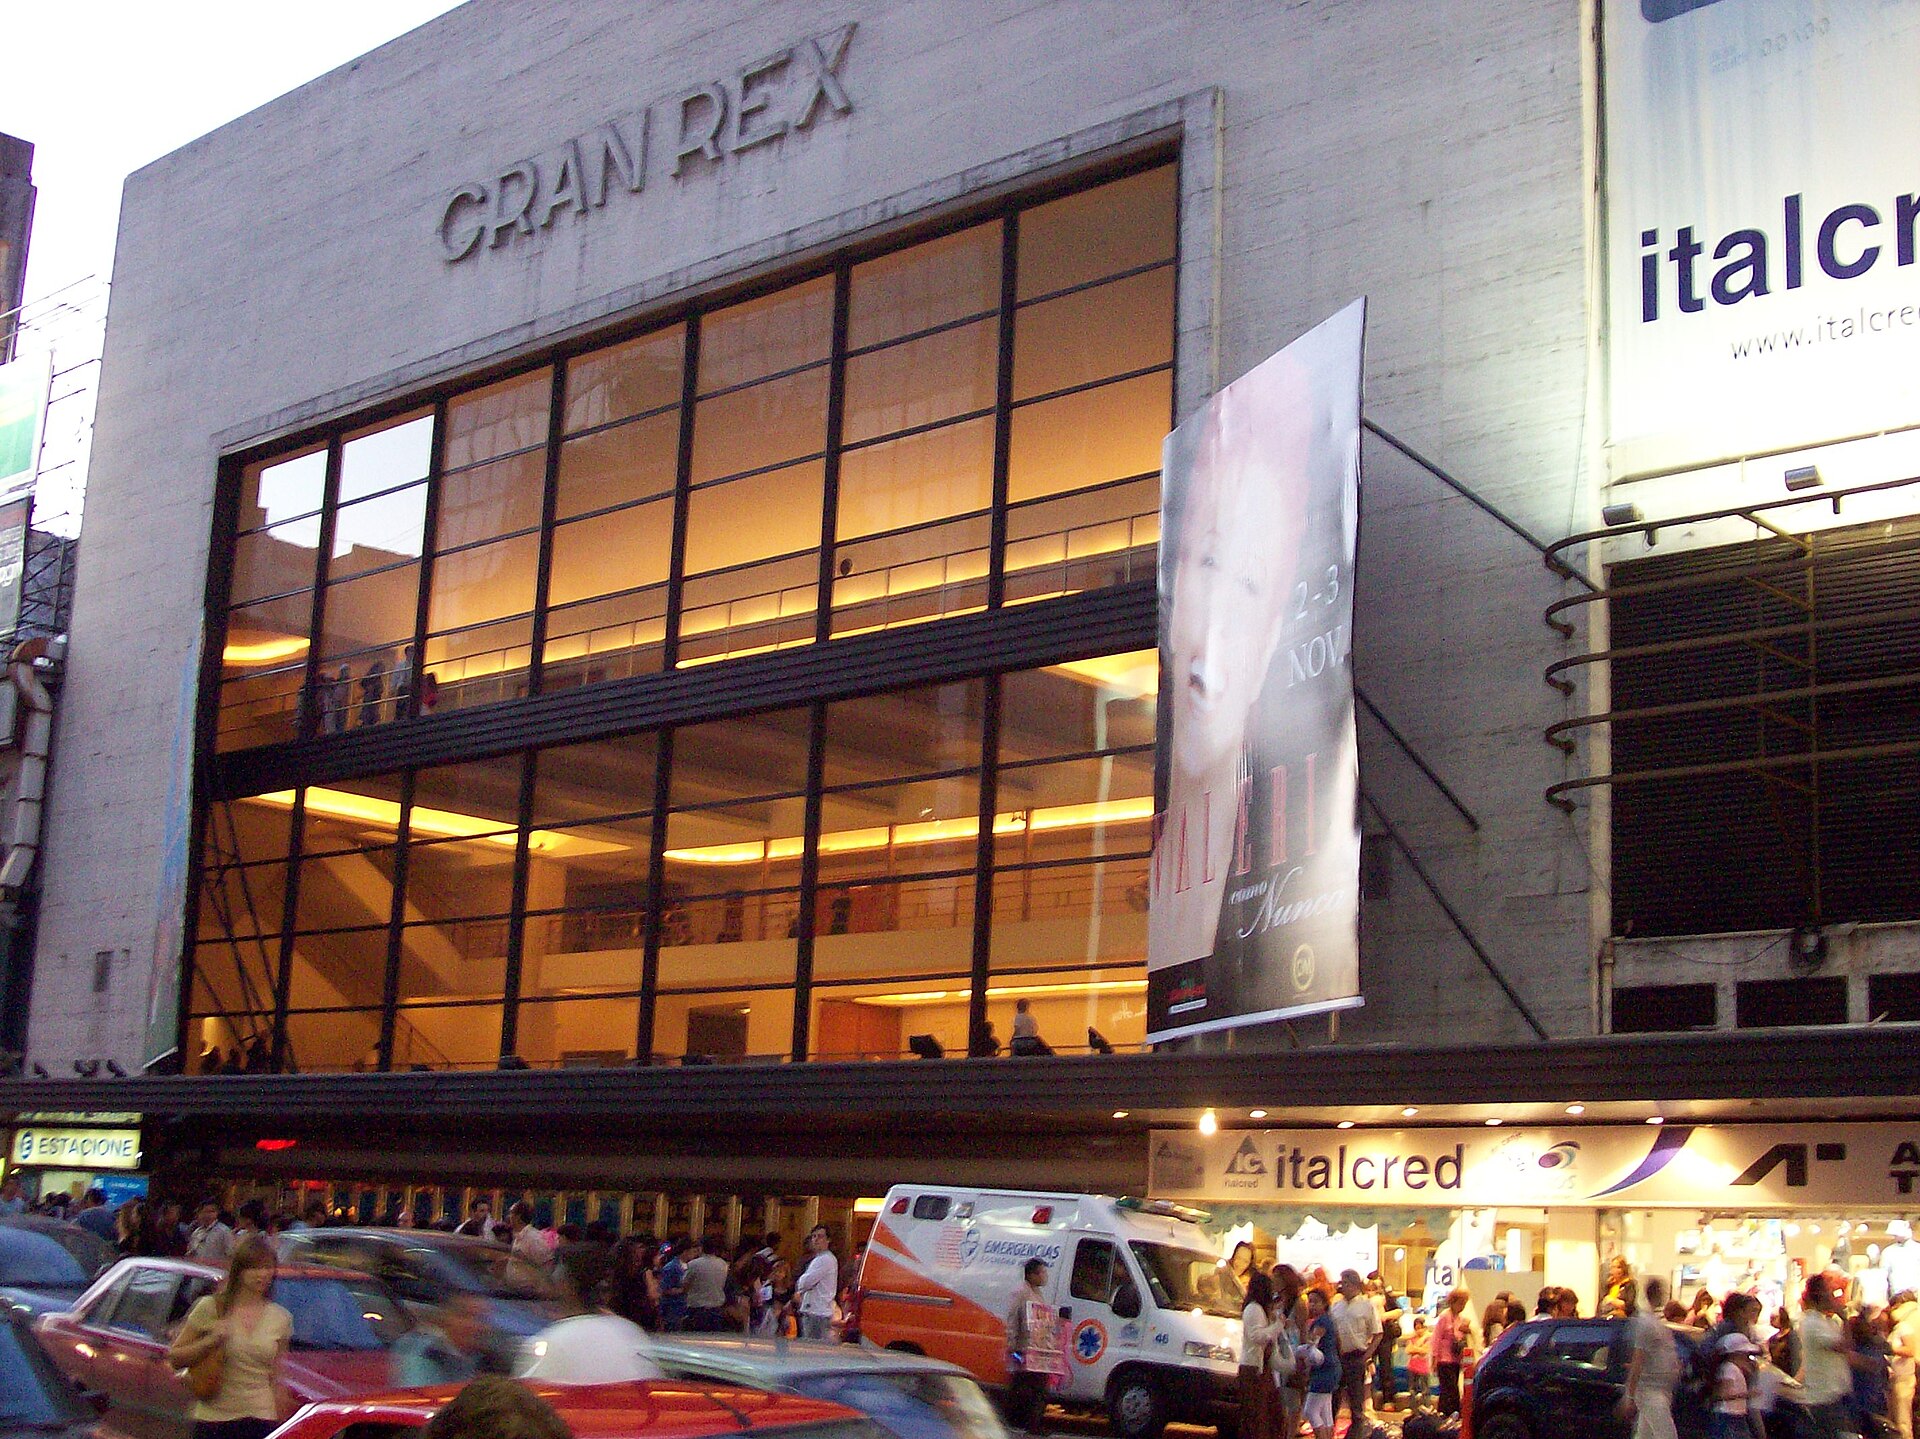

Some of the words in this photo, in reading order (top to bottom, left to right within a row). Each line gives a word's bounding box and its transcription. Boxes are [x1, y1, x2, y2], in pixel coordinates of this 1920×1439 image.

[439, 105, 652, 264] GRAN
[670, 22, 859, 178] REX
[1731, 306, 1920, 359] www.italcre
[1296, 564, 1339, 620] 2-3
[1274, 1144, 1465, 1190] italcred
[984, 1240, 1060, 1259] EMERGENCIAS
